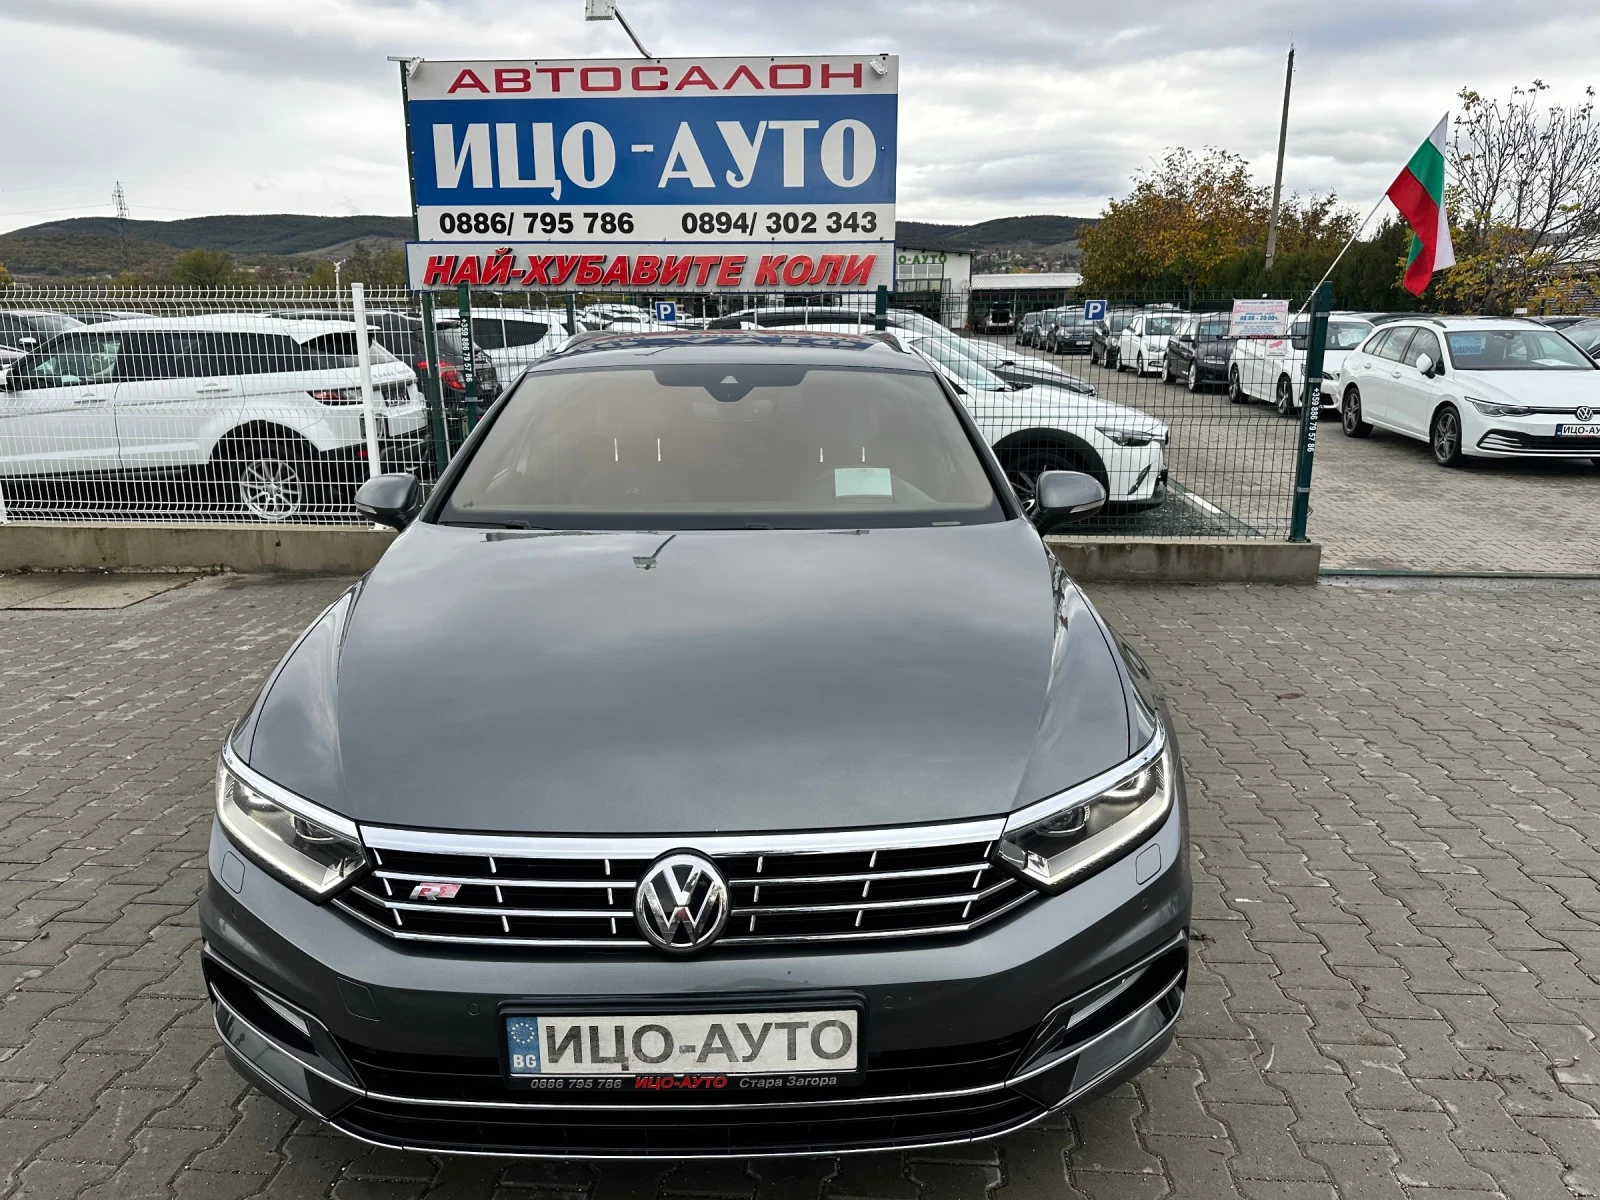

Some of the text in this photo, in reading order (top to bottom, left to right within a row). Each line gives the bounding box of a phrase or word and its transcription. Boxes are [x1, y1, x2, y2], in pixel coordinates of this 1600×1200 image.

[446, 62, 865, 95] АВТОСАЛОН
[438, 210, 878, 236] 0886/ 795 786 0894/ 302 343
[422, 247, 878, 288] НАЙ-ХУБАВИТЕ КОЛИ
[462, 337, 470, 351] 886
[463, 353, 471, 361] 79
[464, 363, 472, 372] 57
[465, 373, 473, 382] 86
[1310, 407, 1319, 420] 886
[1309, 422, 1317, 431] 79
[1308, 432, 1316, 441] 57
[1307, 443, 1315, 453] 86
[545, 1018, 853, 1072] ИЦО-АУТО
[513, 1054, 537, 1069] BG
[530, 1074, 837, 1091] 0886 795 786 ИЦО-АУТО Стара Загора
